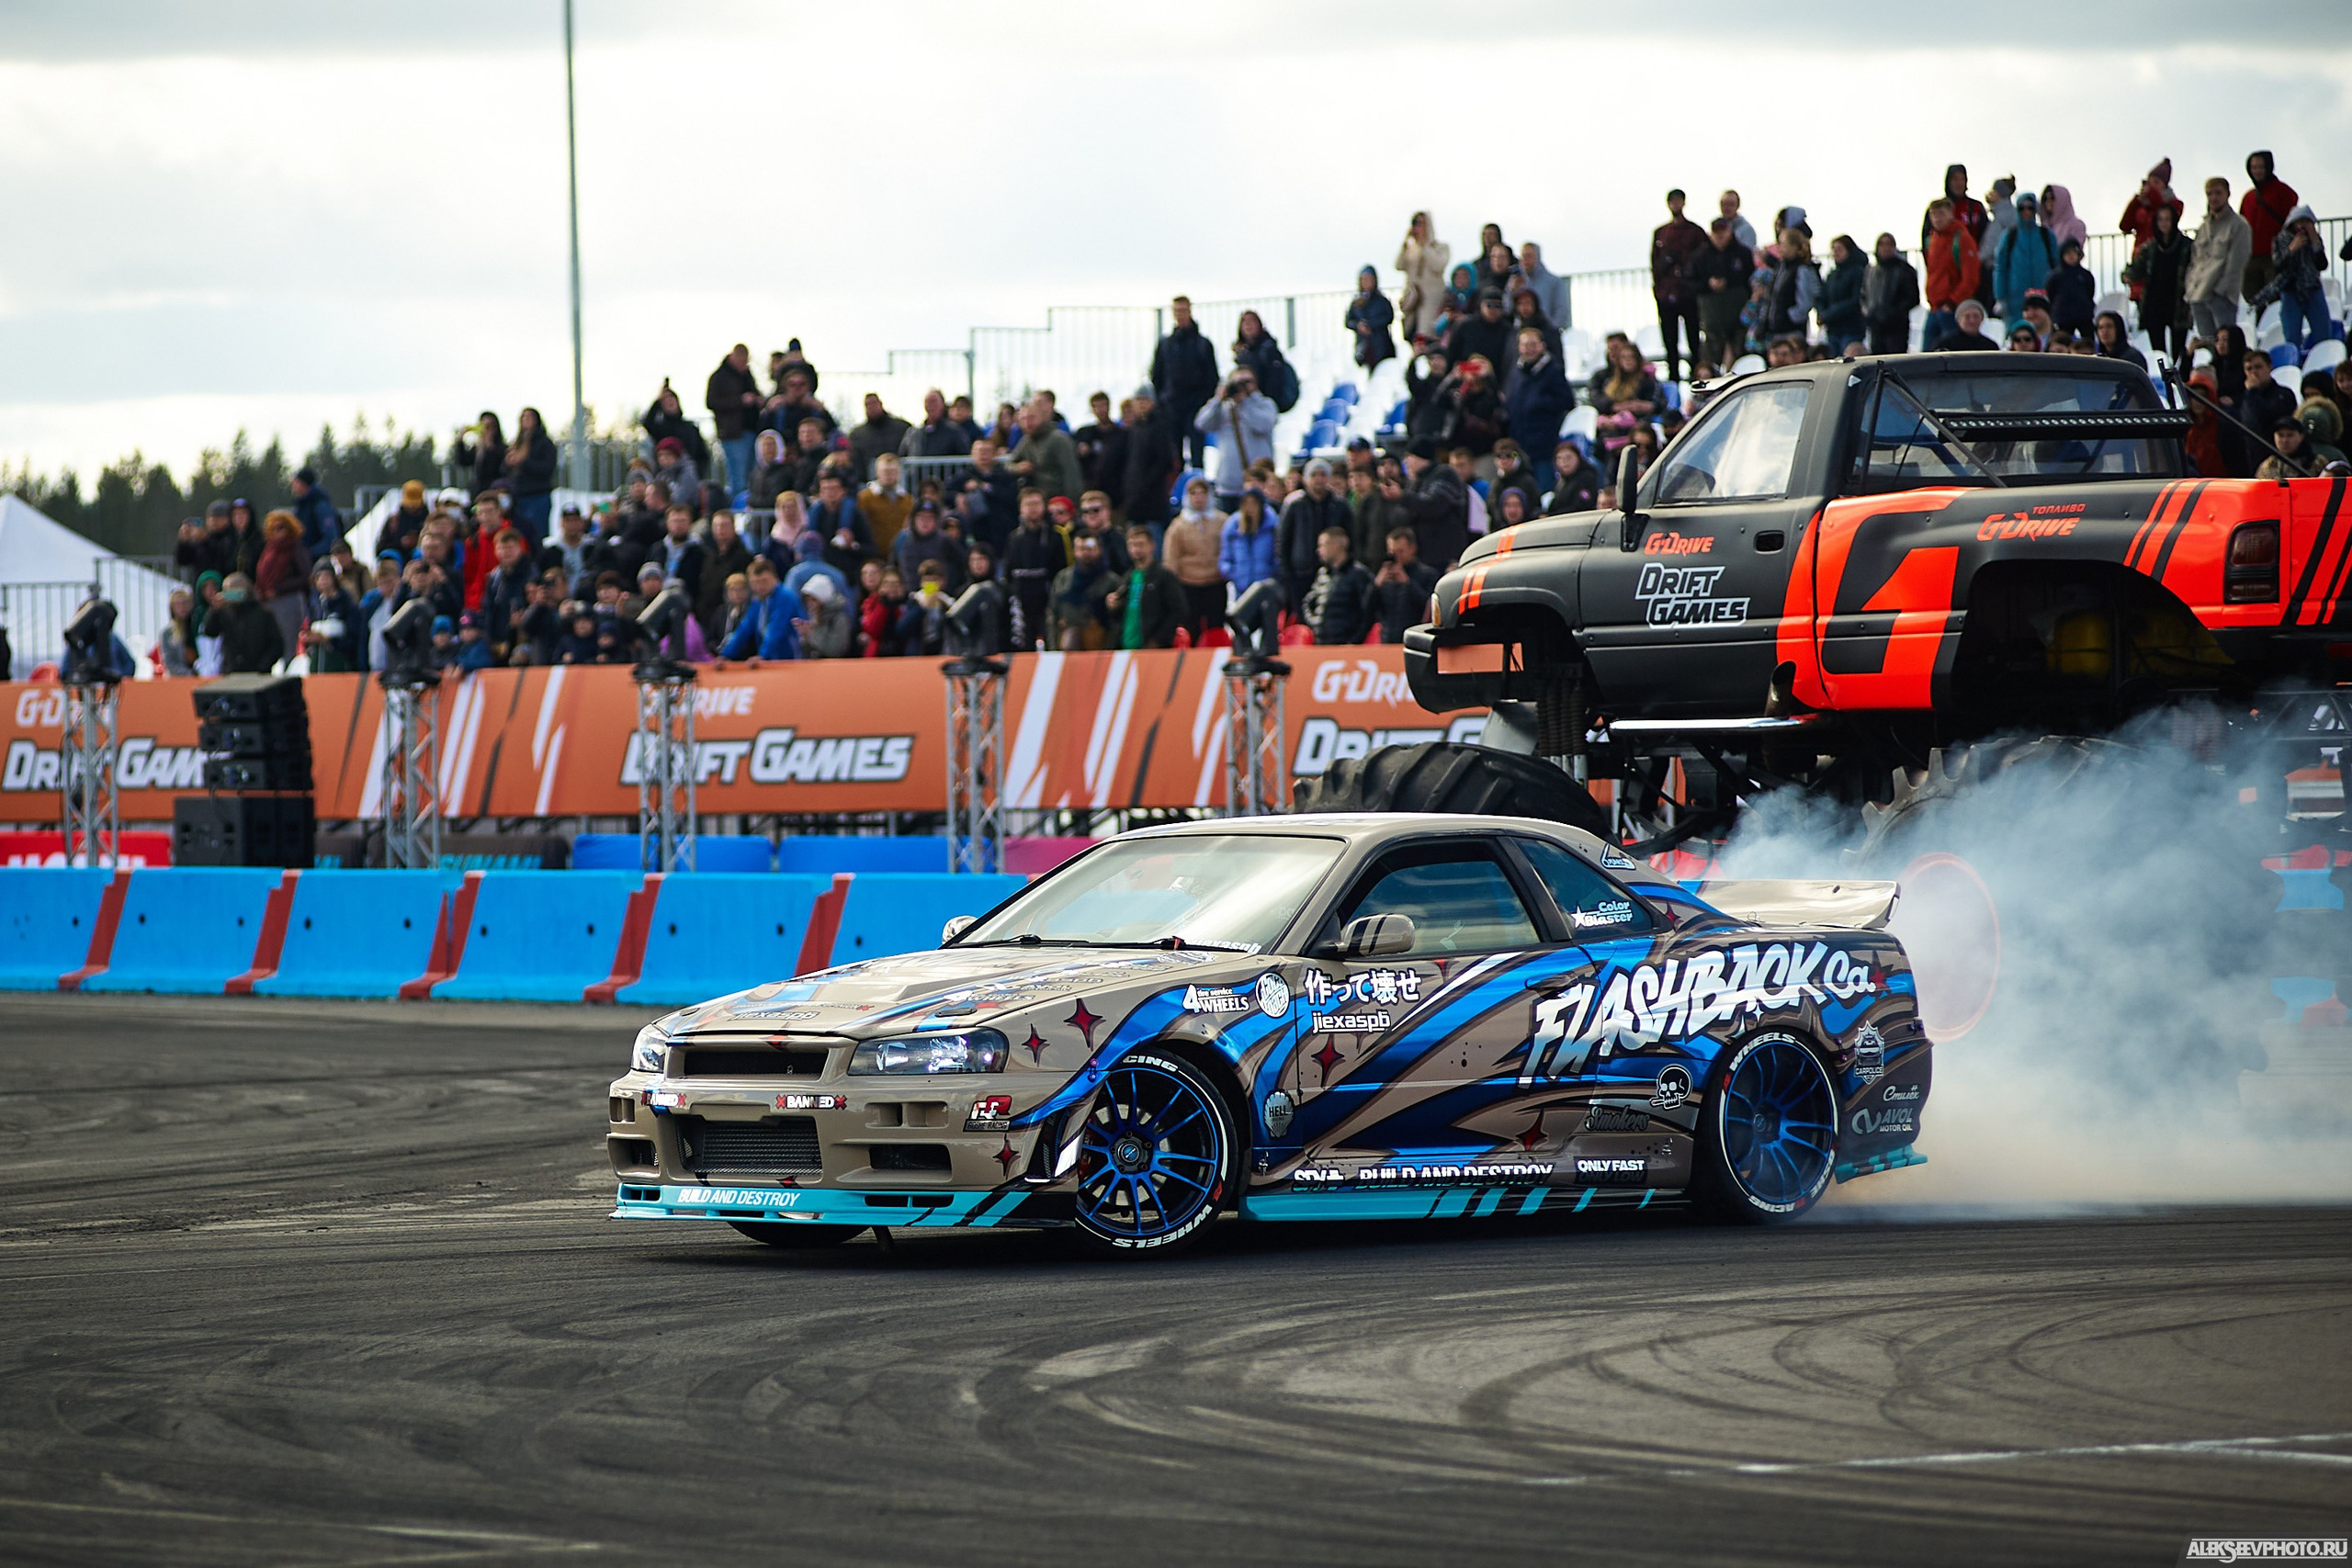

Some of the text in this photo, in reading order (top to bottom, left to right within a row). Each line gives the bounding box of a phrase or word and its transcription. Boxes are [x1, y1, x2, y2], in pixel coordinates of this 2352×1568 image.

[2032, 503, 2086, 514] ТОПЛИВО
[1635, 562, 1725, 600] DRIFT
[1646, 596, 1750, 629] GAMES
[749, 726, 916, 784] GAMES
[1599, 900, 1630, 912] Color
[1584, 912, 1633, 927] Blaster
[1305, 969, 1421, 1005] 作って壊せ
[1198, 997, 1250, 1013] WHEELS
[1519, 941, 1828, 1089] FLASHBACK
[1729, 1032, 1796, 1072] WHEELS
[1122, 1055, 1179, 1072] CING
[1855, 1066, 1883, 1076] CARPOLICE
[786, 1094, 836, 1110] BANNED
[1269, 1105, 1288, 1118] HELL
[1585, 1105, 1650, 1132] Smokers
[1882, 1108, 1913, 1123] AVOL
[1880, 1123, 1913, 1133] MOTOR OIL
[1577, 1159, 1645, 1173] ONLY FAST
[677, 1188, 801, 1208] BUILD AND DESTROY
[1112, 1204, 1213, 1248] WHEELS
